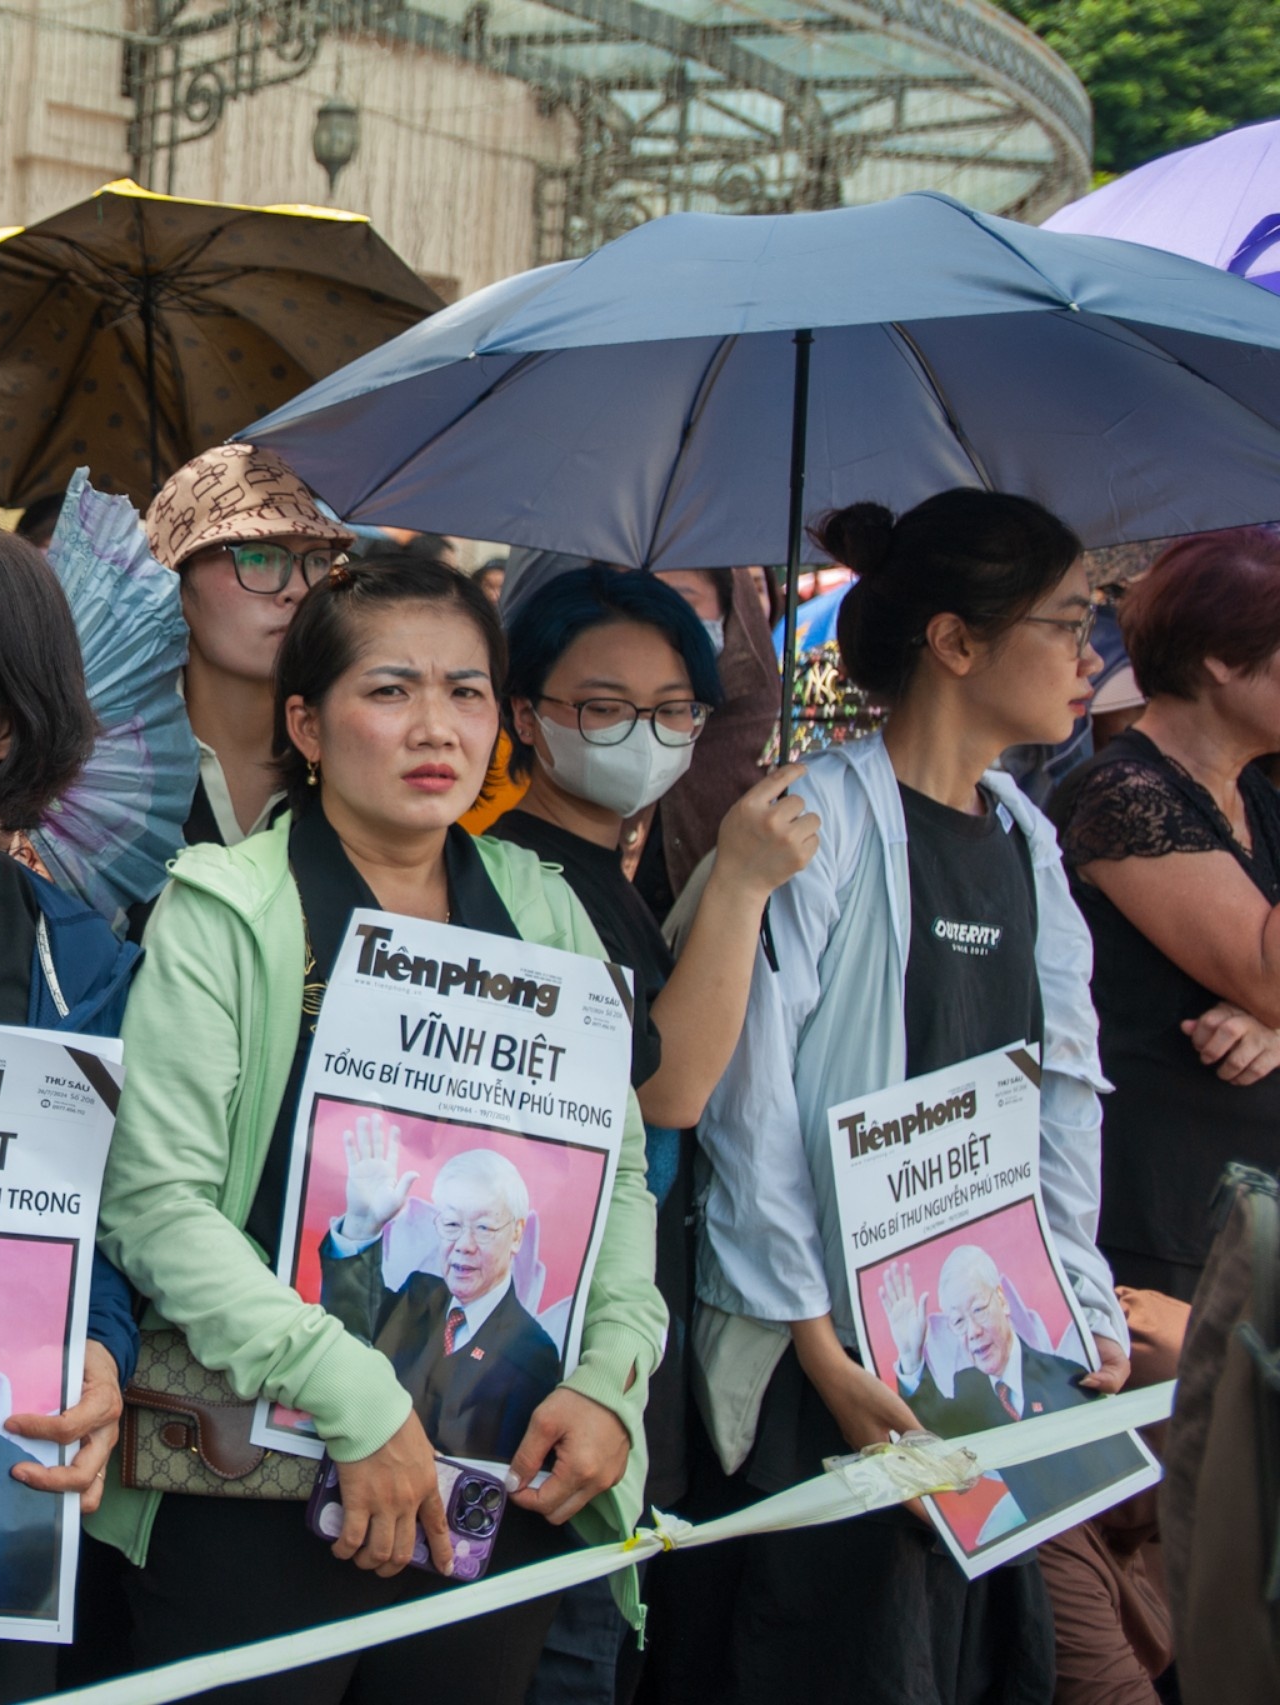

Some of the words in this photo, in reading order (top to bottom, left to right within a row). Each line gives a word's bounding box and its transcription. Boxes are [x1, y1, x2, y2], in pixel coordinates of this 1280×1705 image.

[934, 919, 1000, 946] OUTERITY
[400, 1011, 486, 1066] VĨNH
[490, 1033, 566, 1086] BIỆT
[324, 1048, 376, 1080] TỔNG
[379, 1061, 403, 1085] BÍ
[404, 1068, 445, 1093] THƯ
[446, 1078, 515, 1109] NGUYỄN
[519, 1091, 556, 1116] PHÚ
[558, 1100, 612, 1129] TRỌNG
[7, 1188, 82, 1217] TRỌNG
[886, 1154, 943, 1203] VĨNH
[947, 1133, 991, 1180] BIỆT
[852, 1221, 886, 1250] TỔNG
[888, 1212, 900, 1236] BÍ
[900, 1206, 922, 1230] THƯ
[924, 1184, 969, 1220] NGUYỄN
[970, 1173, 994, 1201] PHÚ
[993, 1161, 1031, 1192] TRỌNG
